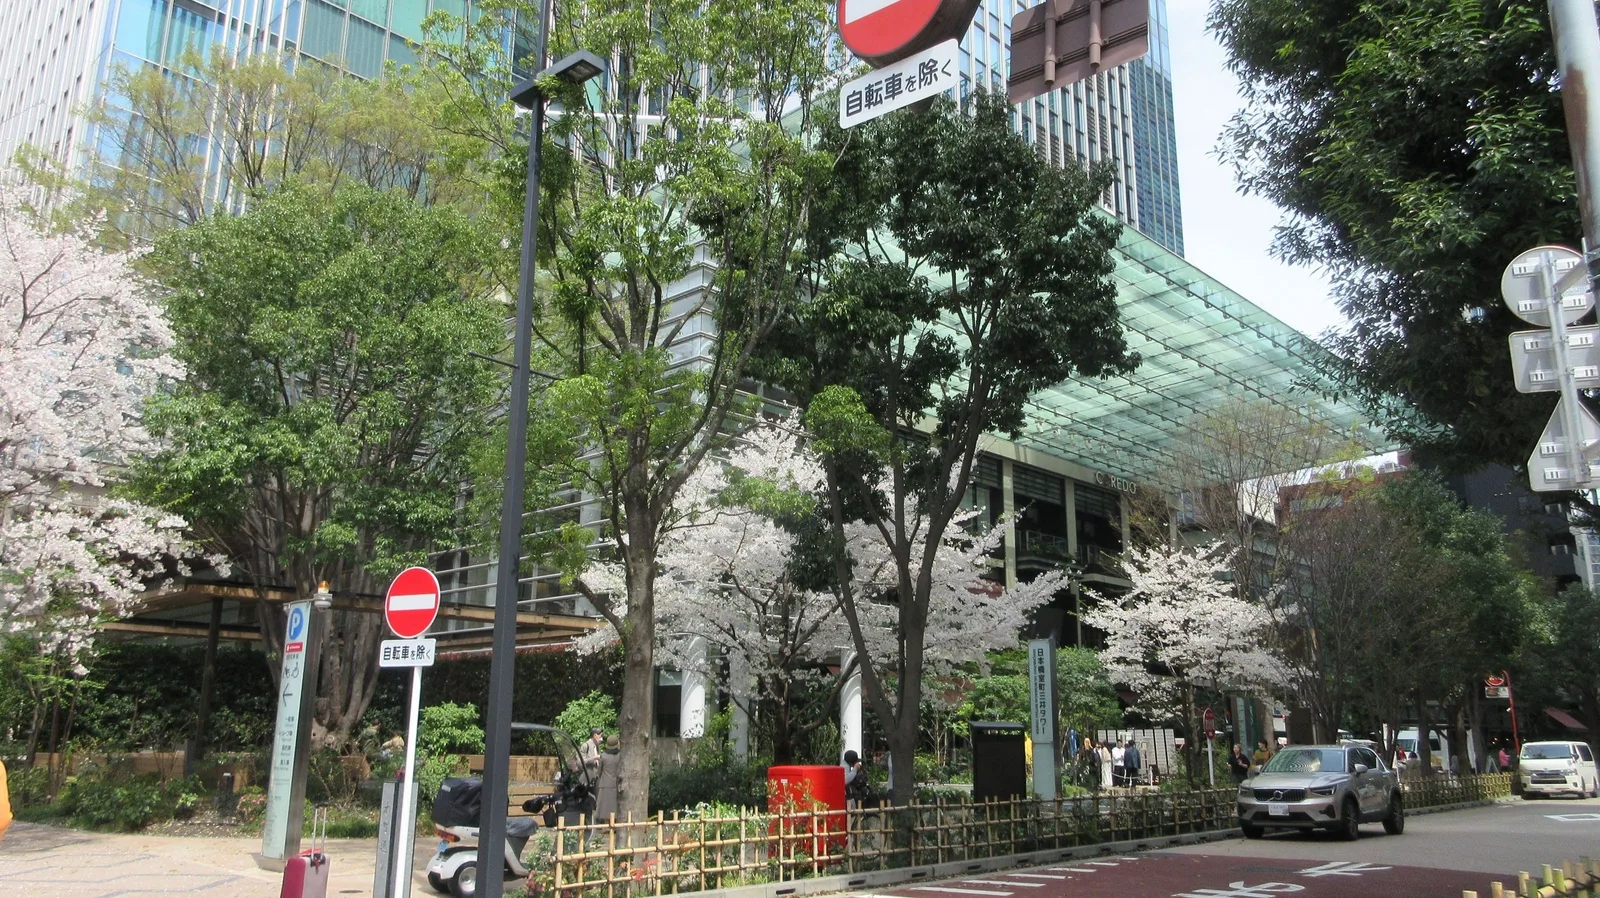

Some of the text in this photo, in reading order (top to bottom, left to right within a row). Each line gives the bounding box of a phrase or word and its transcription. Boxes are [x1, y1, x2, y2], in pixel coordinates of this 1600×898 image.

[846, 58, 952, 117] 自転車を除く
[383, 645, 431, 661] 自転車を除く
[1037, 648, 1046, 735] 日本橋室町三井タワー
